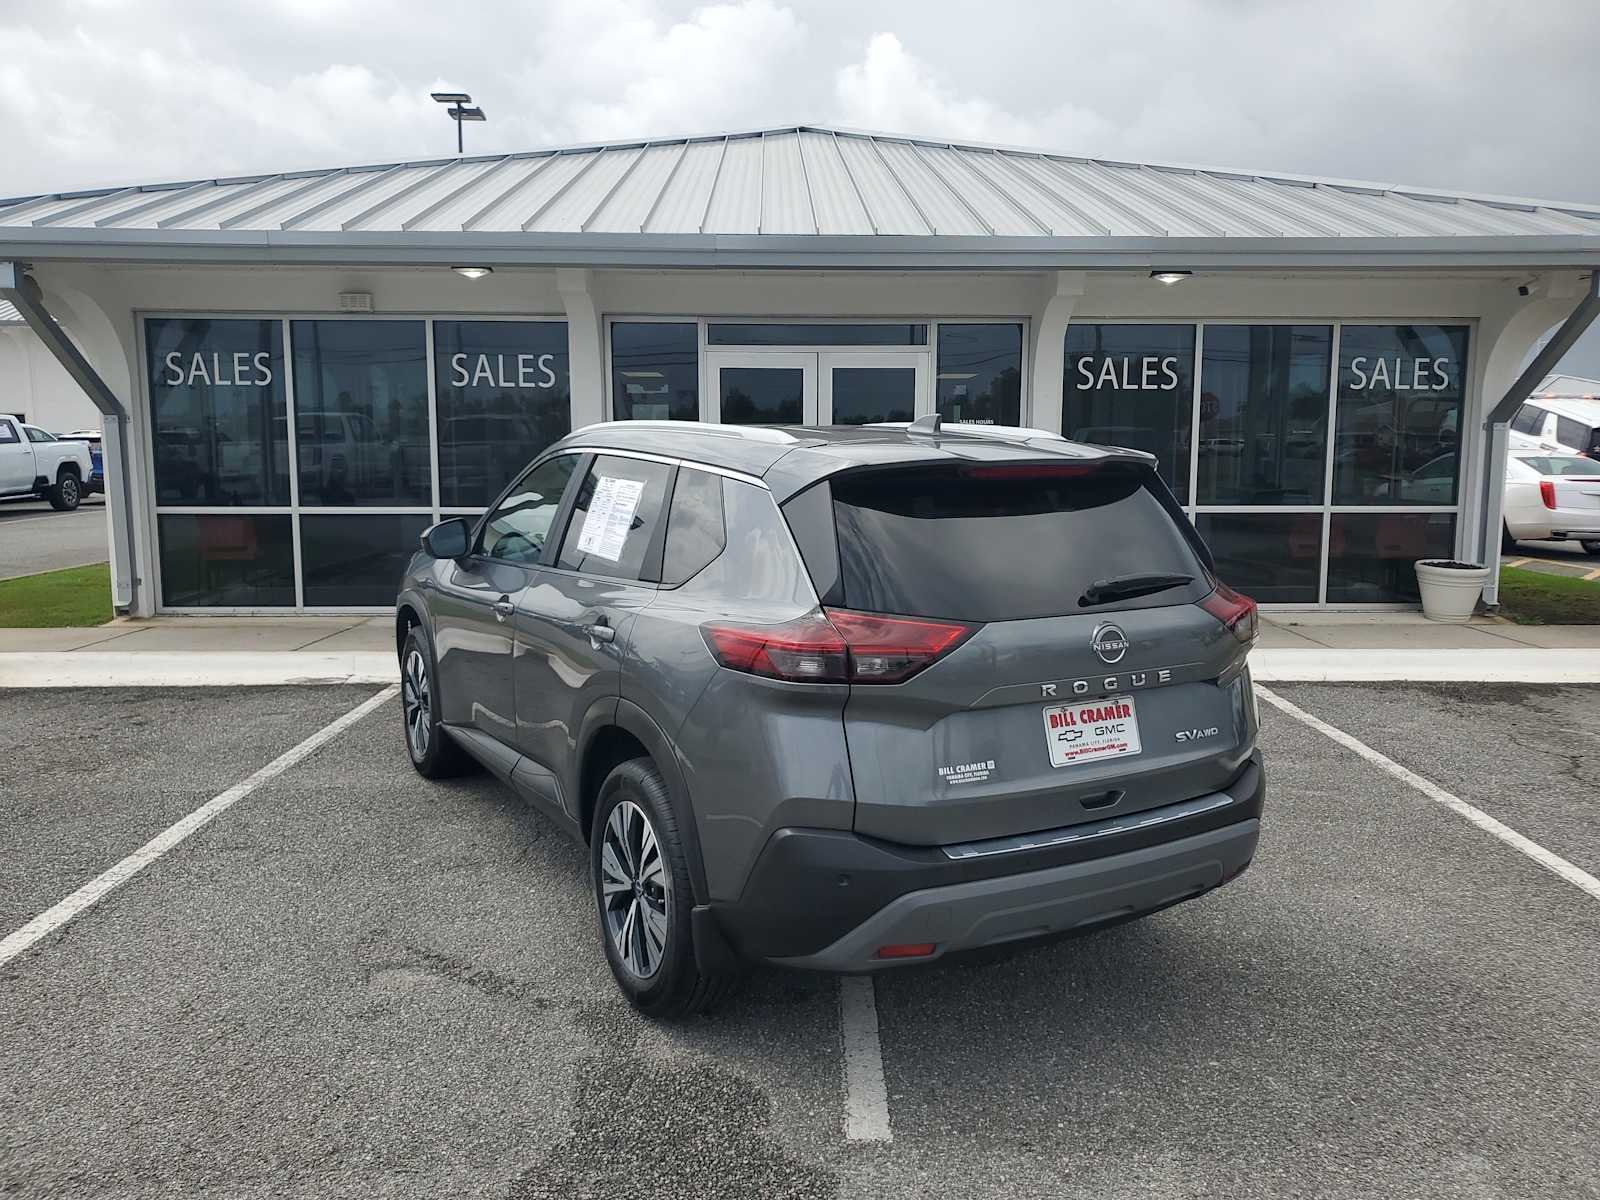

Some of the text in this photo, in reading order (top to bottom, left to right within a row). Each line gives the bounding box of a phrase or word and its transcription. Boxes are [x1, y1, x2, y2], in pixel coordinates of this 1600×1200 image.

[166, 352, 272, 387] SALES
[452, 353, 556, 389] SALES
[1076, 356, 1178, 391] SALES
[1350, 357, 1449, 391] SALES
[1093, 641, 1129, 651] NISSAN
[1041, 669, 1172, 697] ROGUE
[1049, 704, 1131, 728] BILL CRAMER
[1094, 723, 1126, 736] GMC
[1174, 726, 1219, 742] SV AWD
[938, 767, 954, 775] BILL
[956, 762, 987, 773] CRAMER
